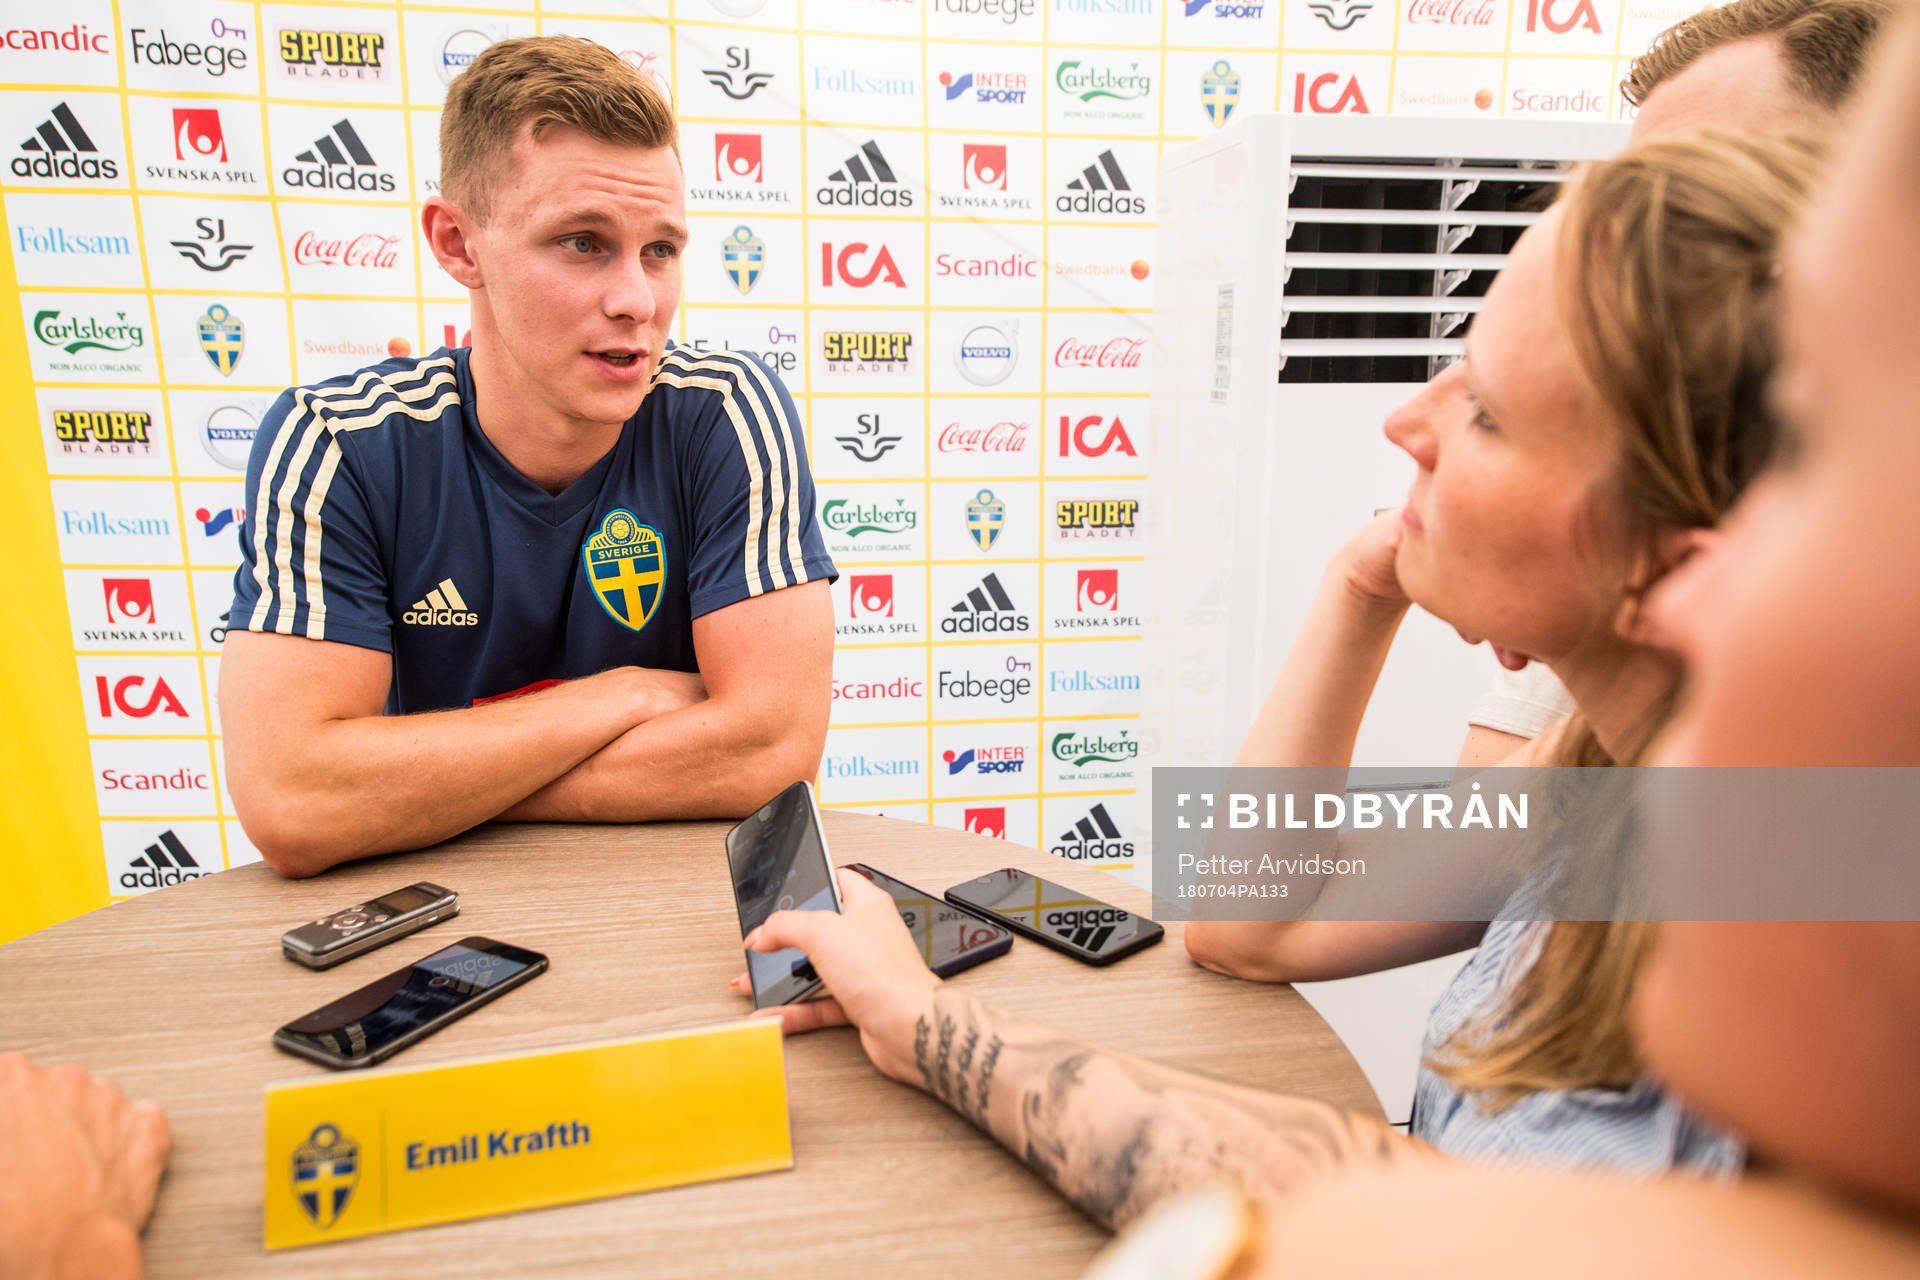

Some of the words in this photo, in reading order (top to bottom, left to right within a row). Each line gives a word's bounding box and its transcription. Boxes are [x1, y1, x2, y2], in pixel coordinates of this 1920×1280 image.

[1525, 0, 1603, 33] ICA
[0, 24, 109, 53] candic
[280, 30, 383, 67] SPORT
[130, 28, 247, 77] Fabege
[726, 46, 751, 71] SJ
[287, 67, 383, 79] BLADET
[815, 66, 914, 96] Folksam
[976, 73, 1027, 89] INTER
[1055, 60, 1152, 96] Carlsberg
[977, 89, 1026, 104] SPORT
[1295, 72, 1369, 113] ICA
[1512, 89, 1603, 112] Scandic
[11, 150, 119, 179] adidas
[146, 166, 222, 182] SVENSKA
[226, 171, 257, 184] SPEL
[282, 164, 396, 193] adidas
[690, 189, 753, 200] SVENSKA
[759, 191, 790, 202] SPEL
[816, 182, 914, 208] adidas
[940, 196, 998, 207] SVENSKA
[1003, 199, 1030, 208] SPEL
[1055, 190, 1147, 215] adidas
[17, 225, 130, 255] Folksam
[195, 216, 226, 243] SJ
[294, 232, 398, 268] Coca-Cola
[822, 242, 906, 288] ICA
[937, 254, 1036, 277] Scandic
[1055, 260, 1127, 278] Swedbank
[33, 308, 144, 355] Carlsberg
[302, 338, 385, 358] Swedbank
[823, 331, 912, 364] SPORT
[964, 348, 1010, 358] VOLVO
[1054, 338, 1144, 368] Coca-Cola
[828, 363, 909, 373] BLADET
[52, 410, 153, 444] SPORT
[856, 413, 881, 437] SJ
[1059, 416, 1137, 457] ICA
[63, 444, 152, 454] BLADET
[938, 423, 1028, 452] Coca-Cola
[62, 510, 170, 536] Folksam
[821, 498, 918, 538] Carlsberg
[1056, 499, 1139, 529] SPORT
[1060, 529, 1136, 539] BLADET
[598, 544, 649, 560] SVERIGE
[402, 608, 479, 627] adidas
[835, 623, 885, 635] VENSKA
[889, 624, 917, 633] SPEL
[940, 610, 1030, 634] adidas
[1055, 618, 1109, 628] SVENSKA
[1113, 617, 1140, 626] SPEL
[84, 632, 147, 640] SVENSKA
[152, 632, 184, 640] SPEL
[831, 676, 923, 700] Scandic
[938, 669, 1032, 704] Fabege
[1051, 671, 1140, 692] Folksam
[96, 675, 189, 718] ICA
[976, 746, 1025, 760] INTER
[1051, 731, 1139, 768] Carlsberg
[827, 756, 919, 778] Folksam
[977, 760, 1024, 775] SPORT
[102, 768, 209, 791] Scandic
[1050, 839, 1135, 861] adidas
[120, 867, 213, 888] adid
[404, 1135, 478, 1172] Emil
[487, 1118, 592, 1158] Krafth
